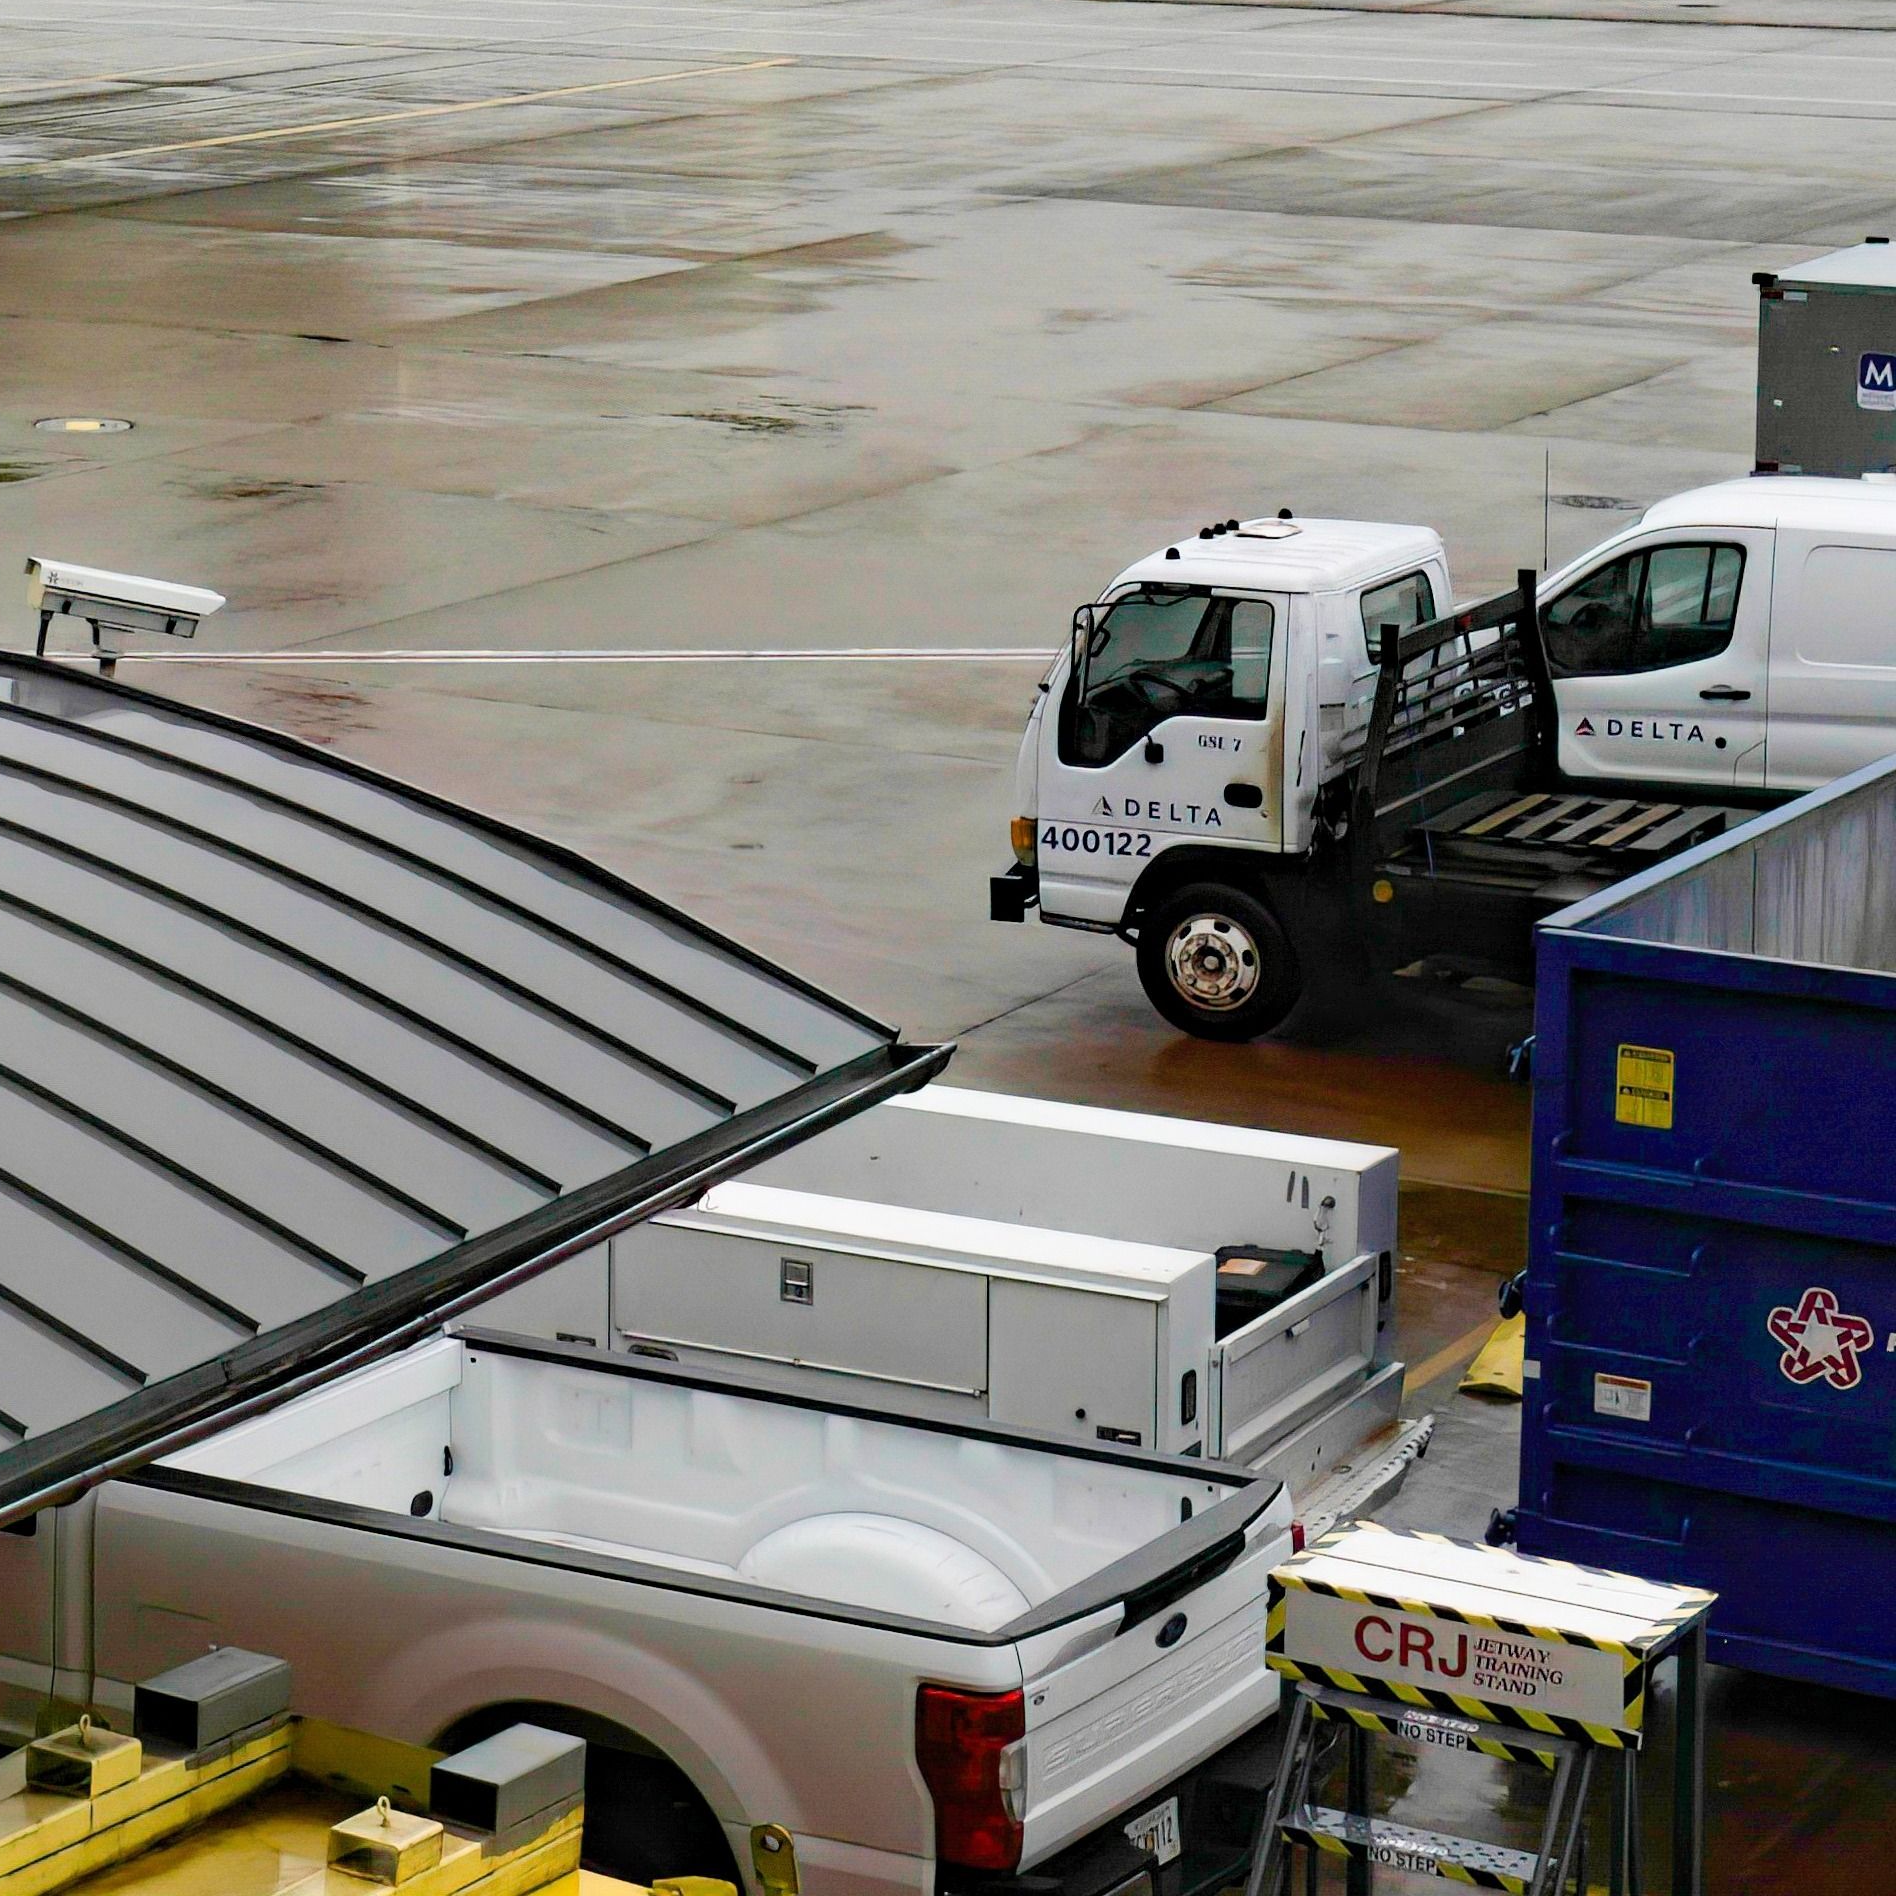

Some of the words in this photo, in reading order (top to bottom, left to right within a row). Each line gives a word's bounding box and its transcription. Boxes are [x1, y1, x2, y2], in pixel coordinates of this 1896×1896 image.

[1865, 360, 1893, 387] M
[1608, 719, 1704, 742] DELTA
[1233, 738, 1242, 752] 7
[1125, 798, 1221, 826] DELTA
[1041, 826, 1152, 857] 400122
[1354, 1615, 1468, 1678] CRJ
[1473, 1638, 1550, 1664] JETWAY
[1475, 1655, 1563, 1685] TRAINING
[1473, 1672, 1537, 1696] STAND
[1399, 1721, 1421, 1739] NO
[1427, 1728, 1465, 1749] STEP
[1369, 1846, 1391, 1862] NO
[1397, 1852, 1436, 1872] STEP
